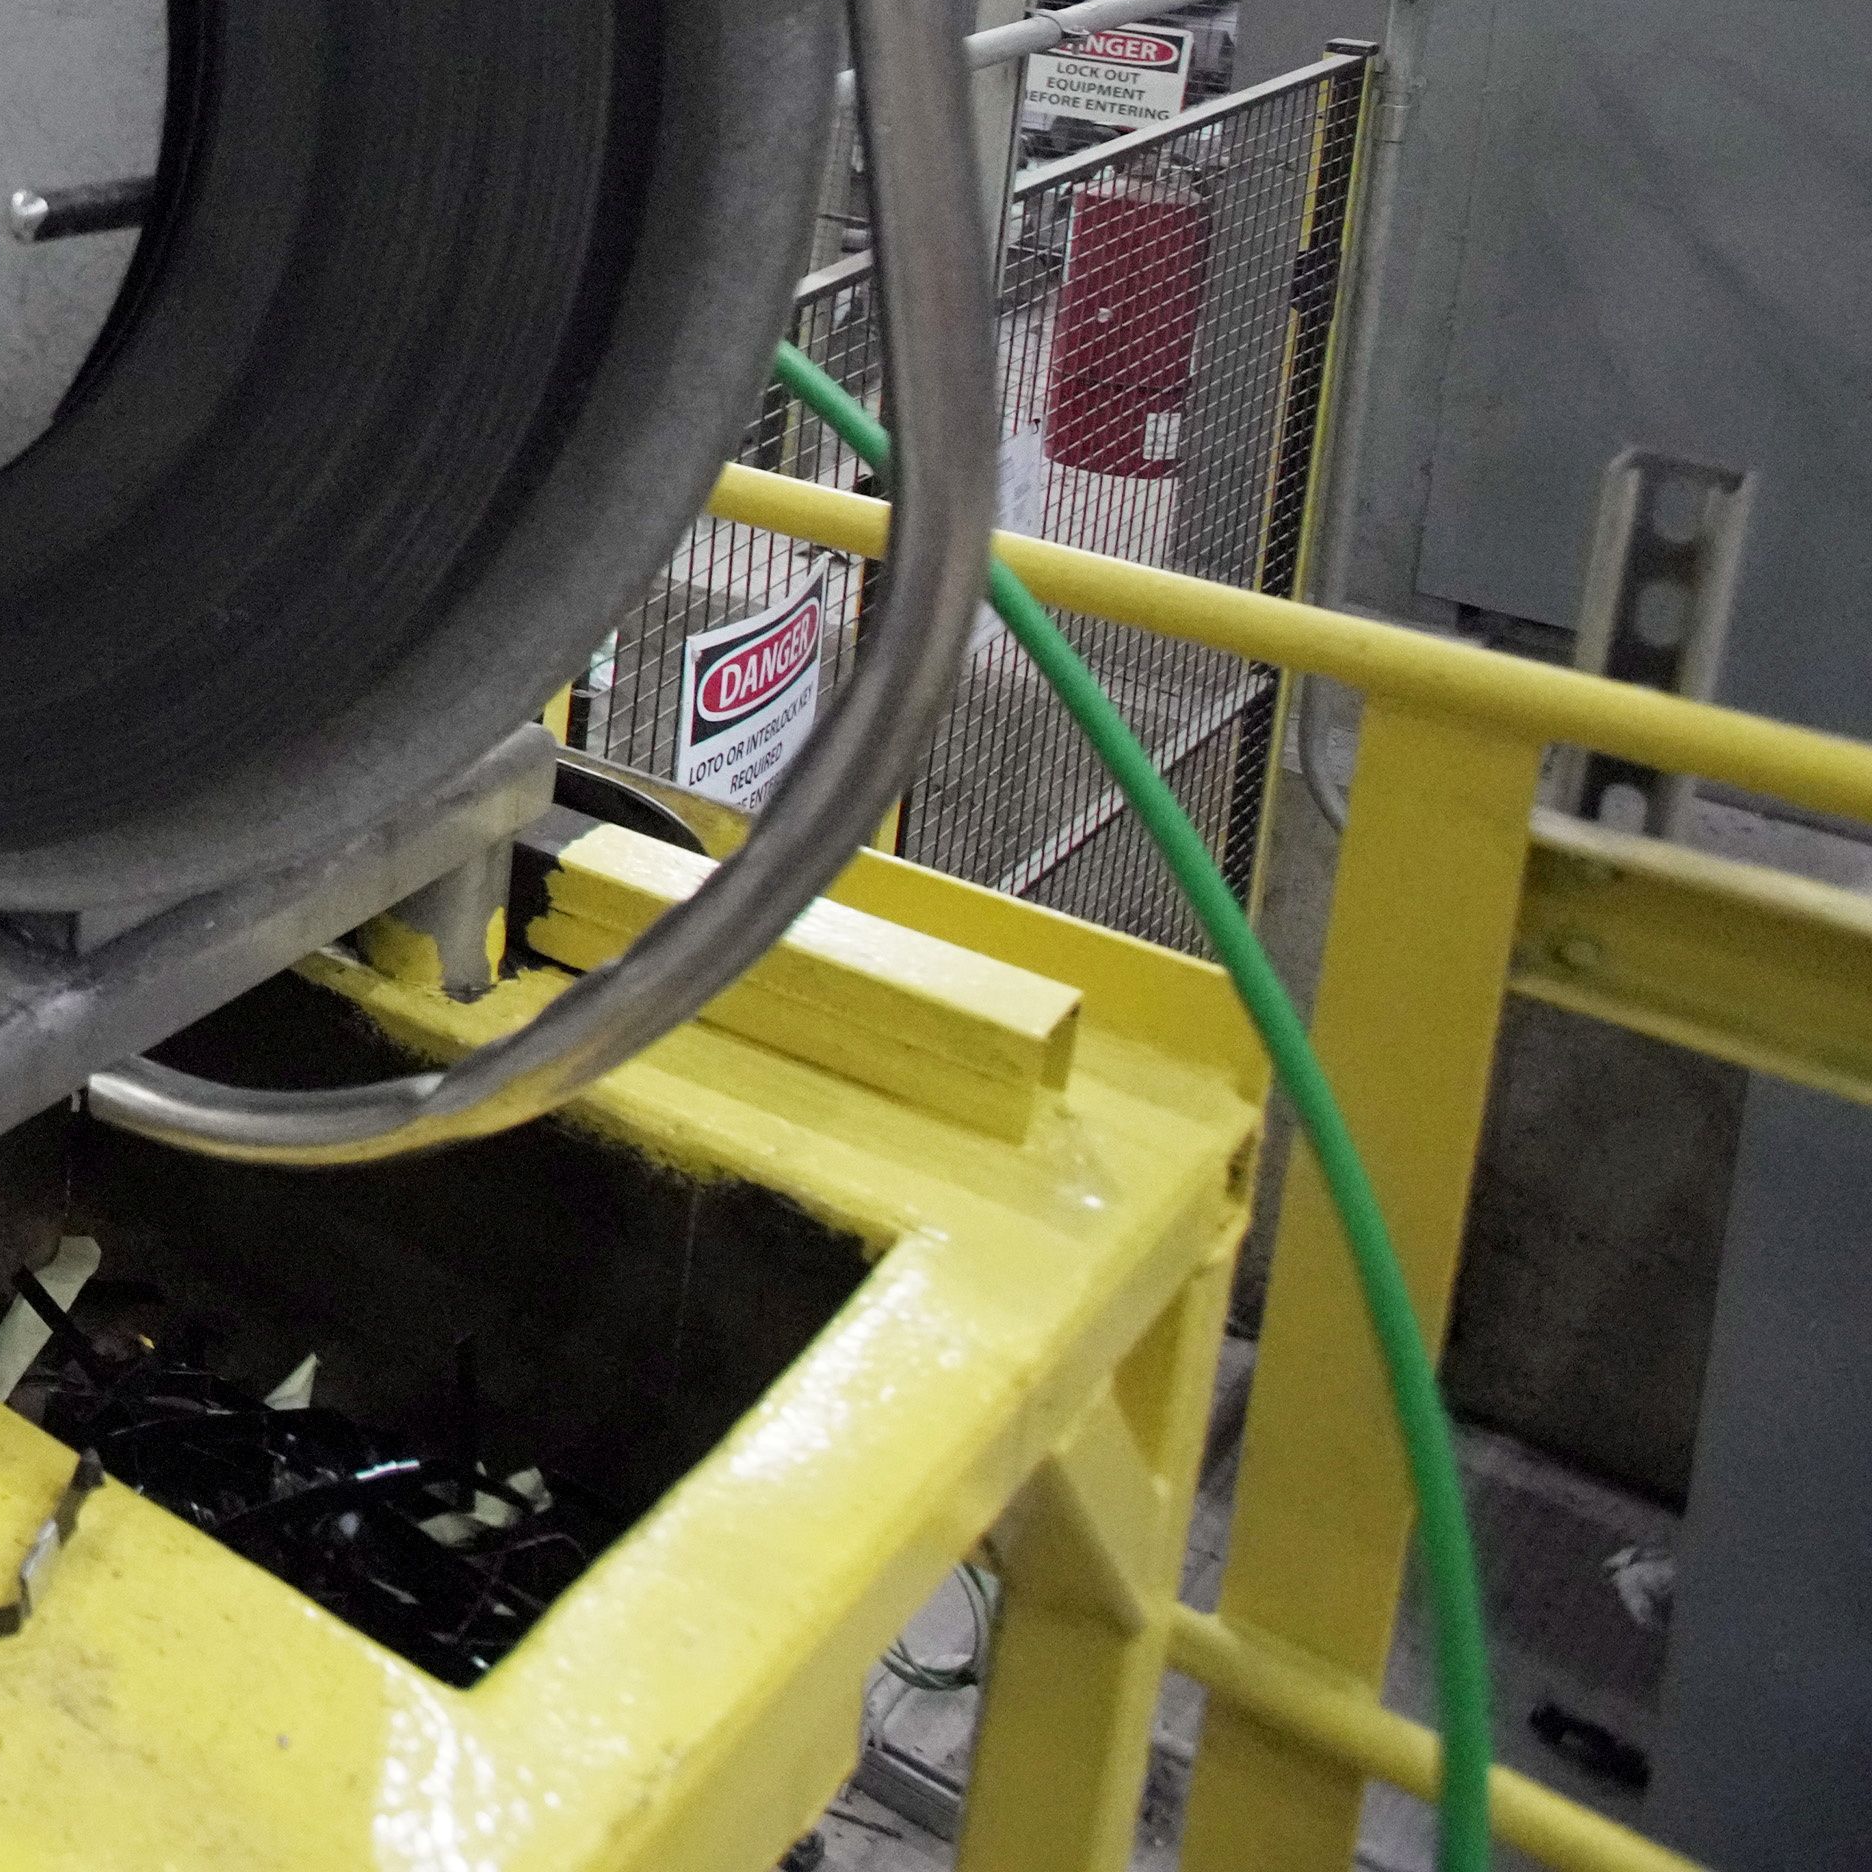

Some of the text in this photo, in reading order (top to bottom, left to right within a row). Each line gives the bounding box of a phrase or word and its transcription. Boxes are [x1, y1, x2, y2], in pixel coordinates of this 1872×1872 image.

[1066, 34, 1157, 61] NGER
[1057, 62, 1141, 84] LOCK OUT
[1046, 78, 1146, 101] EQUIPMENT
[1085, 99, 1170, 121] ENTERING
[719, 613, 811, 709] DANGER
[689, 753, 724, 787] LOTO
[726, 740, 745, 766] OR
[746, 698, 798, 756] INTERLOCK
[730, 741, 783, 795] REQUIRED
